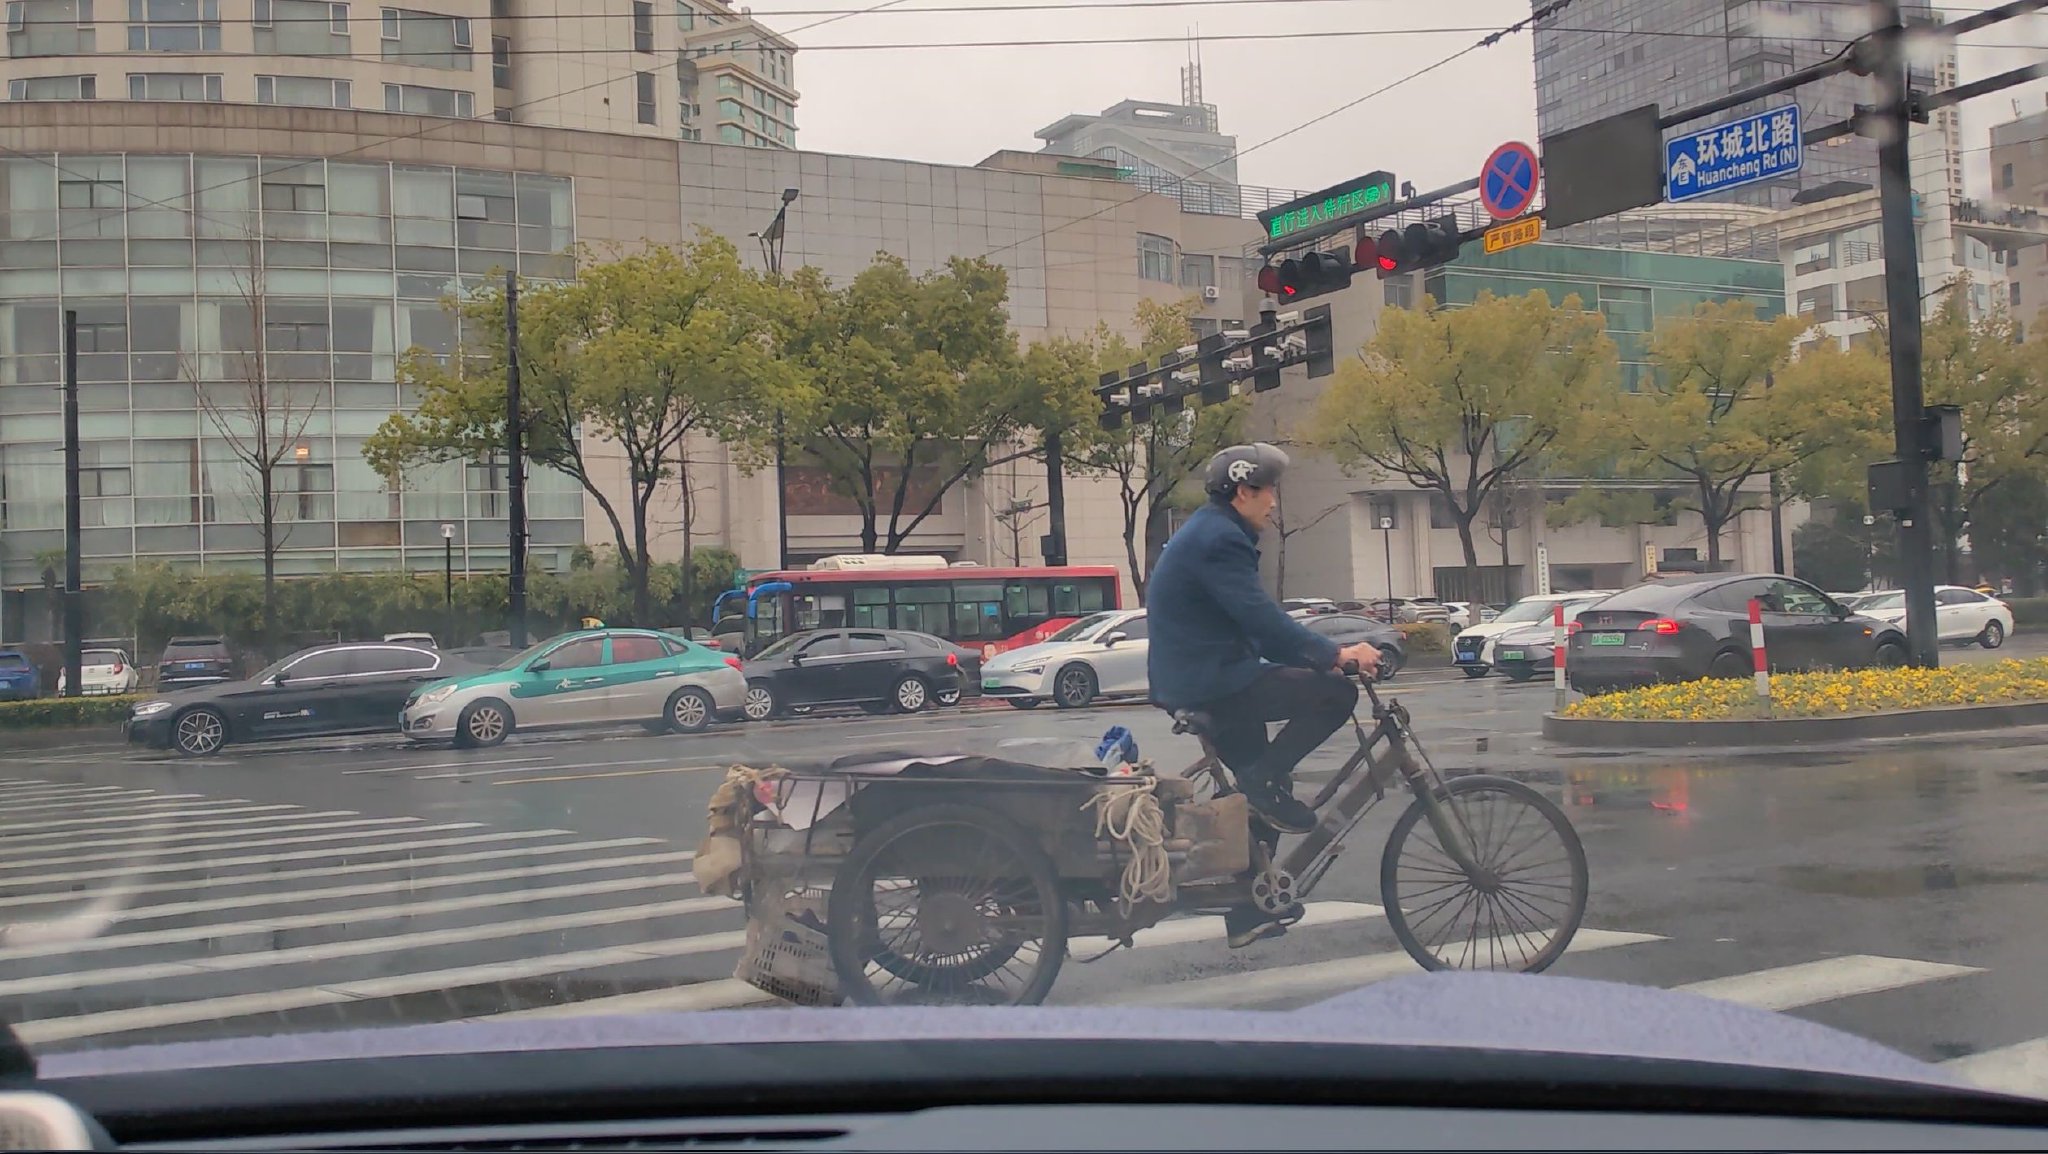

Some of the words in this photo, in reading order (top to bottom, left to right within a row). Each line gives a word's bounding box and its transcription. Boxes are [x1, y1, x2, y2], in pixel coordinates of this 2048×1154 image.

[1696, 111, 1795, 166] 环城北路
[1697, 159, 1760, 188] Huancheng
[1763, 151, 1778, 171] Rd
[1780, 145, 1797, 166] (N)
[1270, 188, 1365, 239] 直行进入待行区
